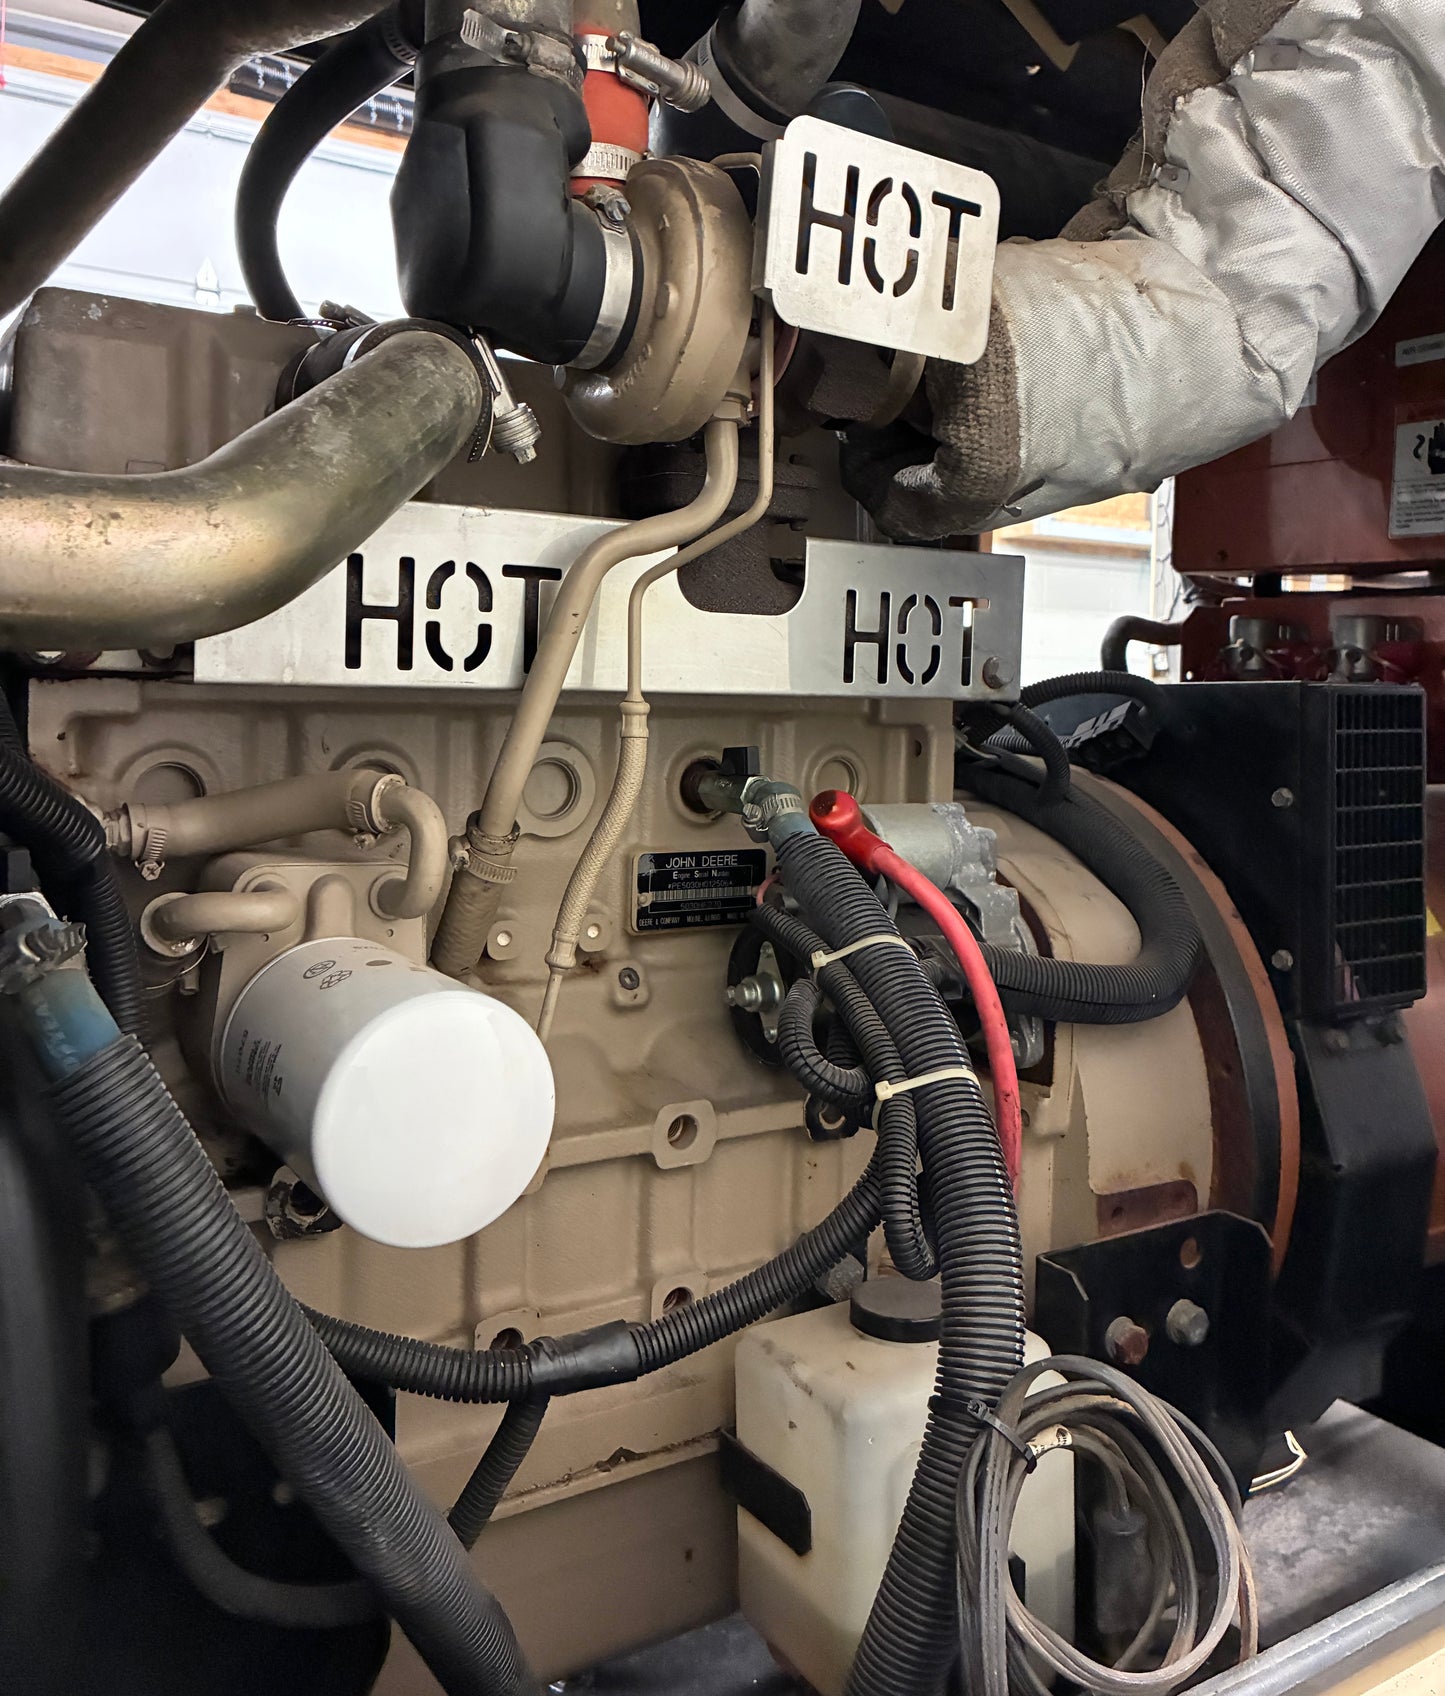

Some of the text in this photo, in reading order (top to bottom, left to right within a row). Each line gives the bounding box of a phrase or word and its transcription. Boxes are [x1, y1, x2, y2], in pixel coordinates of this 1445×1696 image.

[795, 151, 982, 312] HOT
[344, 552, 562, 675] HOT
[843, 588, 991, 687] HOT
[665, 854, 739, 868] JOHN DEERE
[639, 918, 653, 927] DEERE
[660, 916, 680, 925] COMPANY
